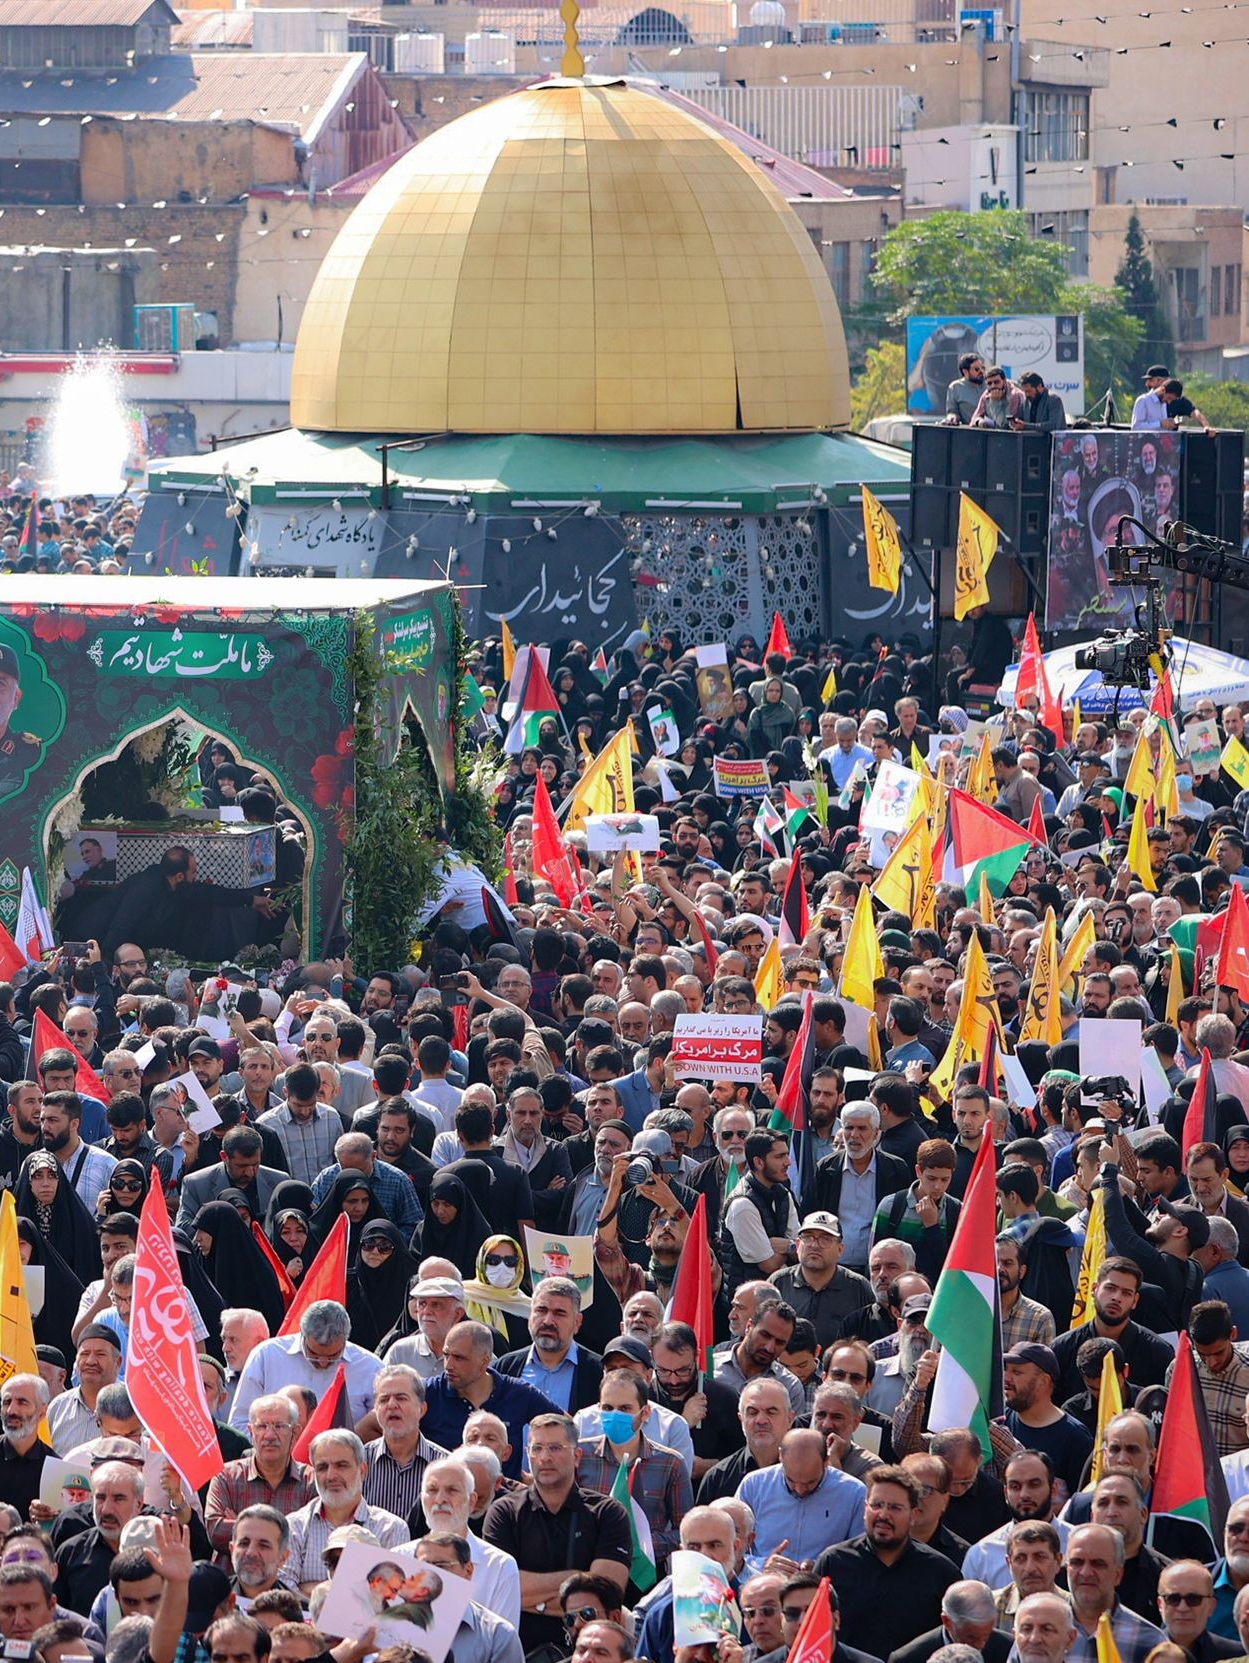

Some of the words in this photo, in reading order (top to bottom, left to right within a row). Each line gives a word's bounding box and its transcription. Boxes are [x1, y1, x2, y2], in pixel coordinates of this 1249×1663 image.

[241, 640, 252, 673] ما
[727, 1042, 758, 1060] مرگ
[707, 1065, 732, 1074] WITH
[734, 1066, 759, 1076] U.S.A
